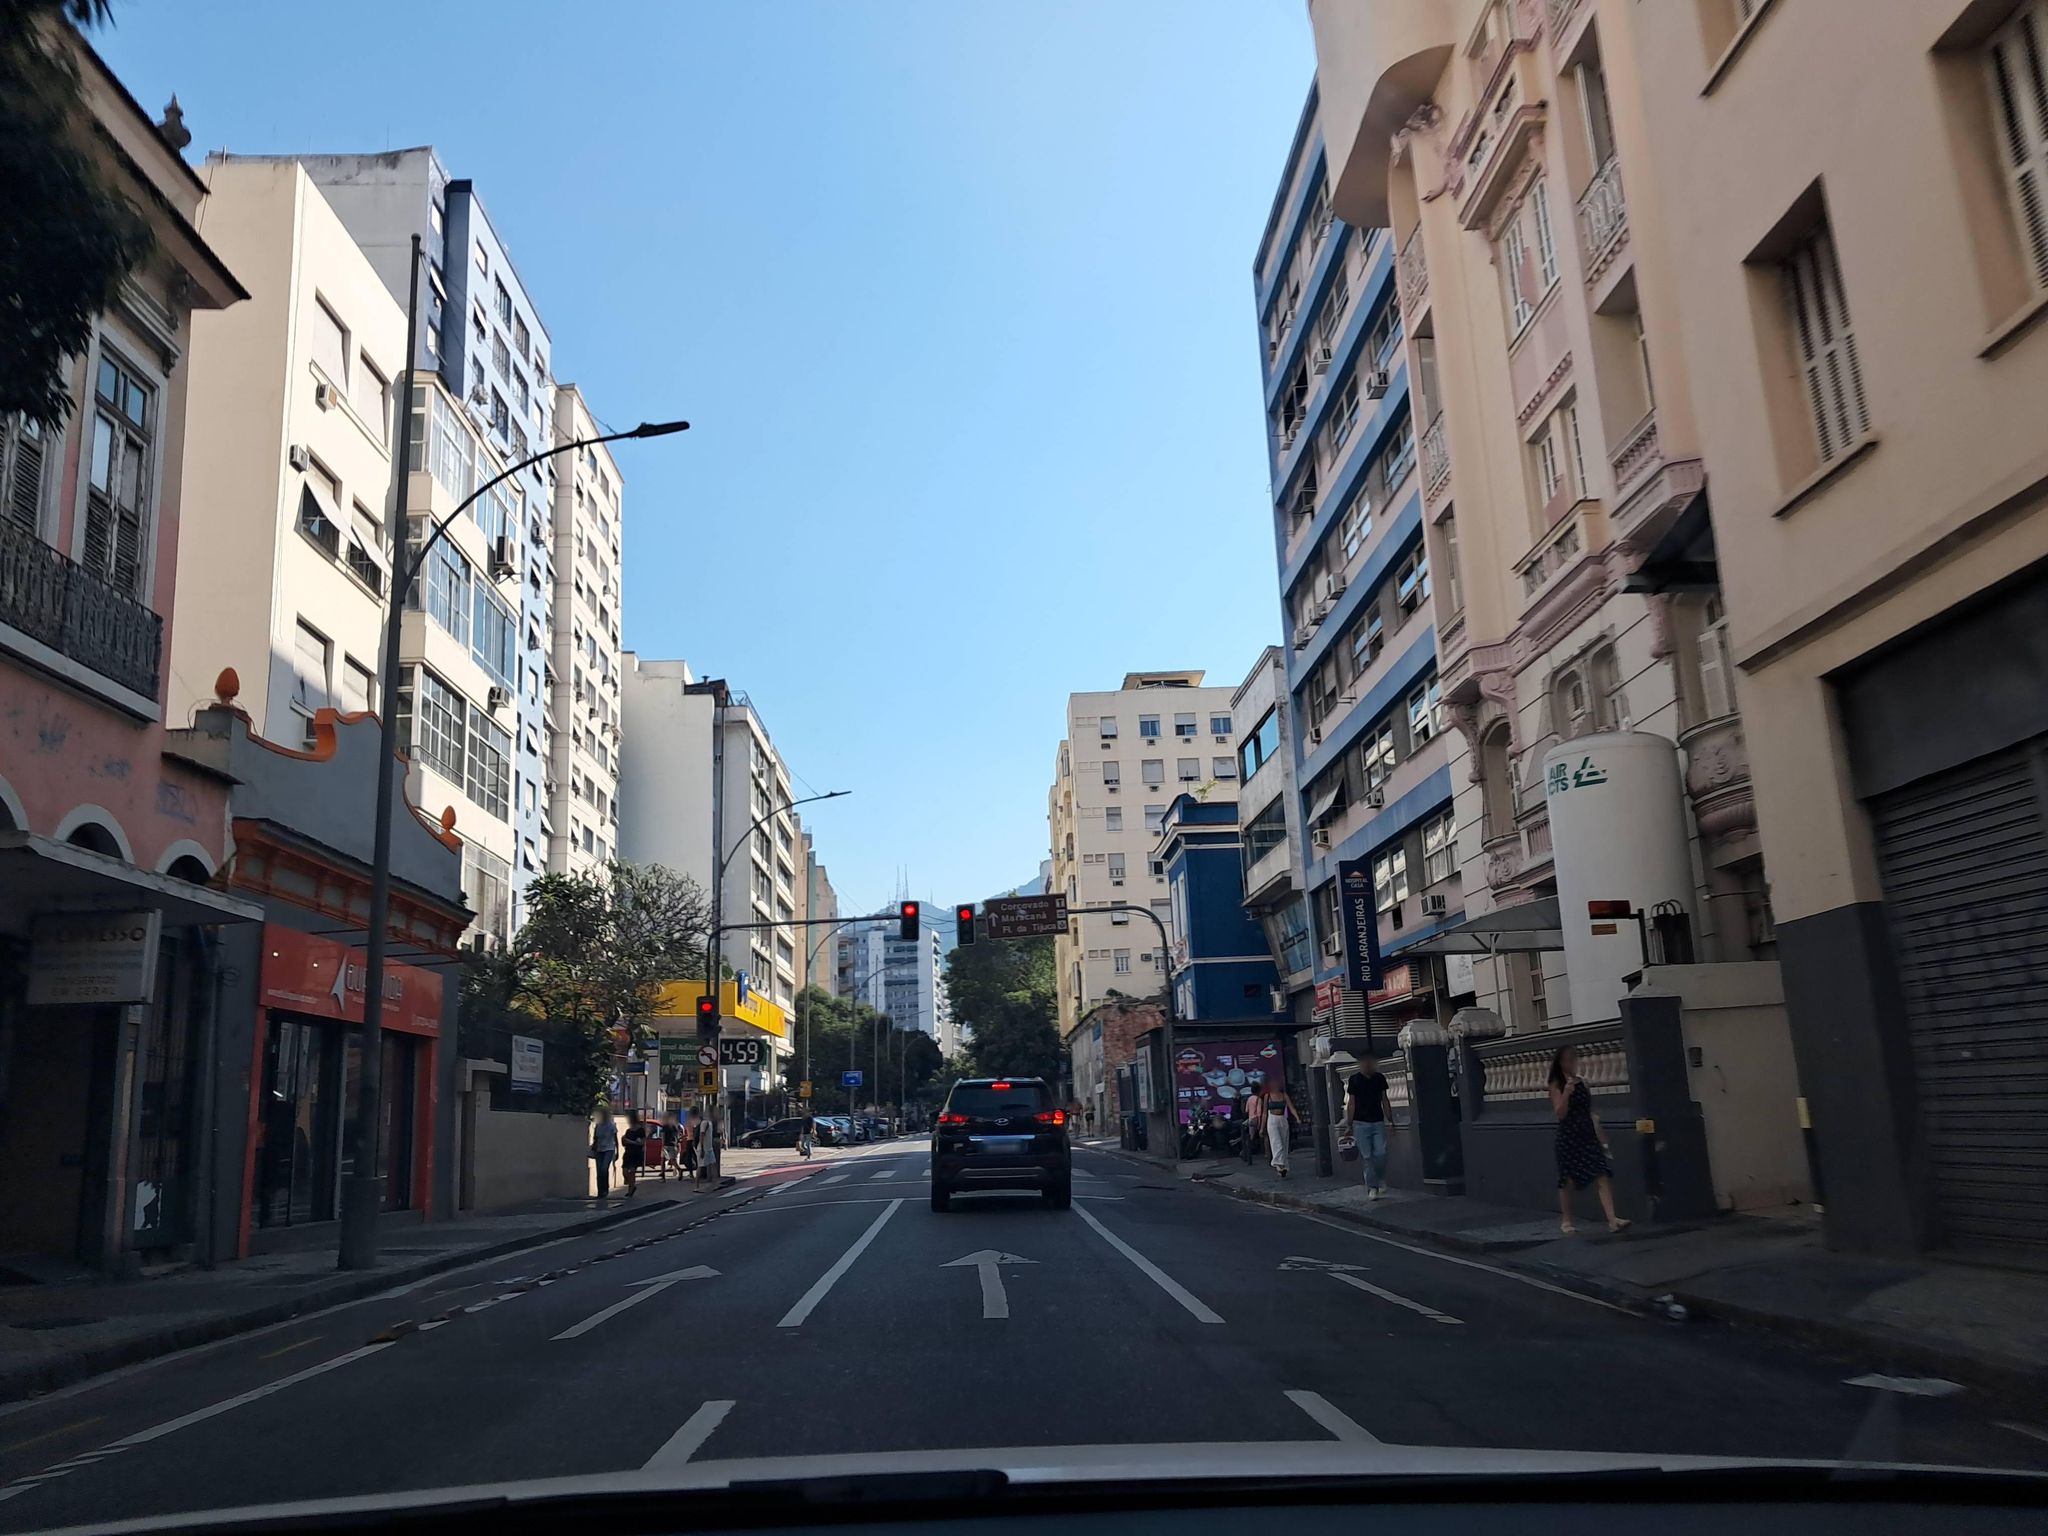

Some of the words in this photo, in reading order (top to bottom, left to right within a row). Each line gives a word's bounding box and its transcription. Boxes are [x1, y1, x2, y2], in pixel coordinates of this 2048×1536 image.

[1550, 763, 1567, 779] AIR
[1000, 901, 1049, 911] Corcovado
[1016, 925, 1027, 933] da
[1032, 923, 1057, 932] Tijuca
[1354, 898, 1370, 963] LARANJEIRAS
[1361, 965, 1372, 982] RIO
[721, 1042, 758, 1063] 4,59
